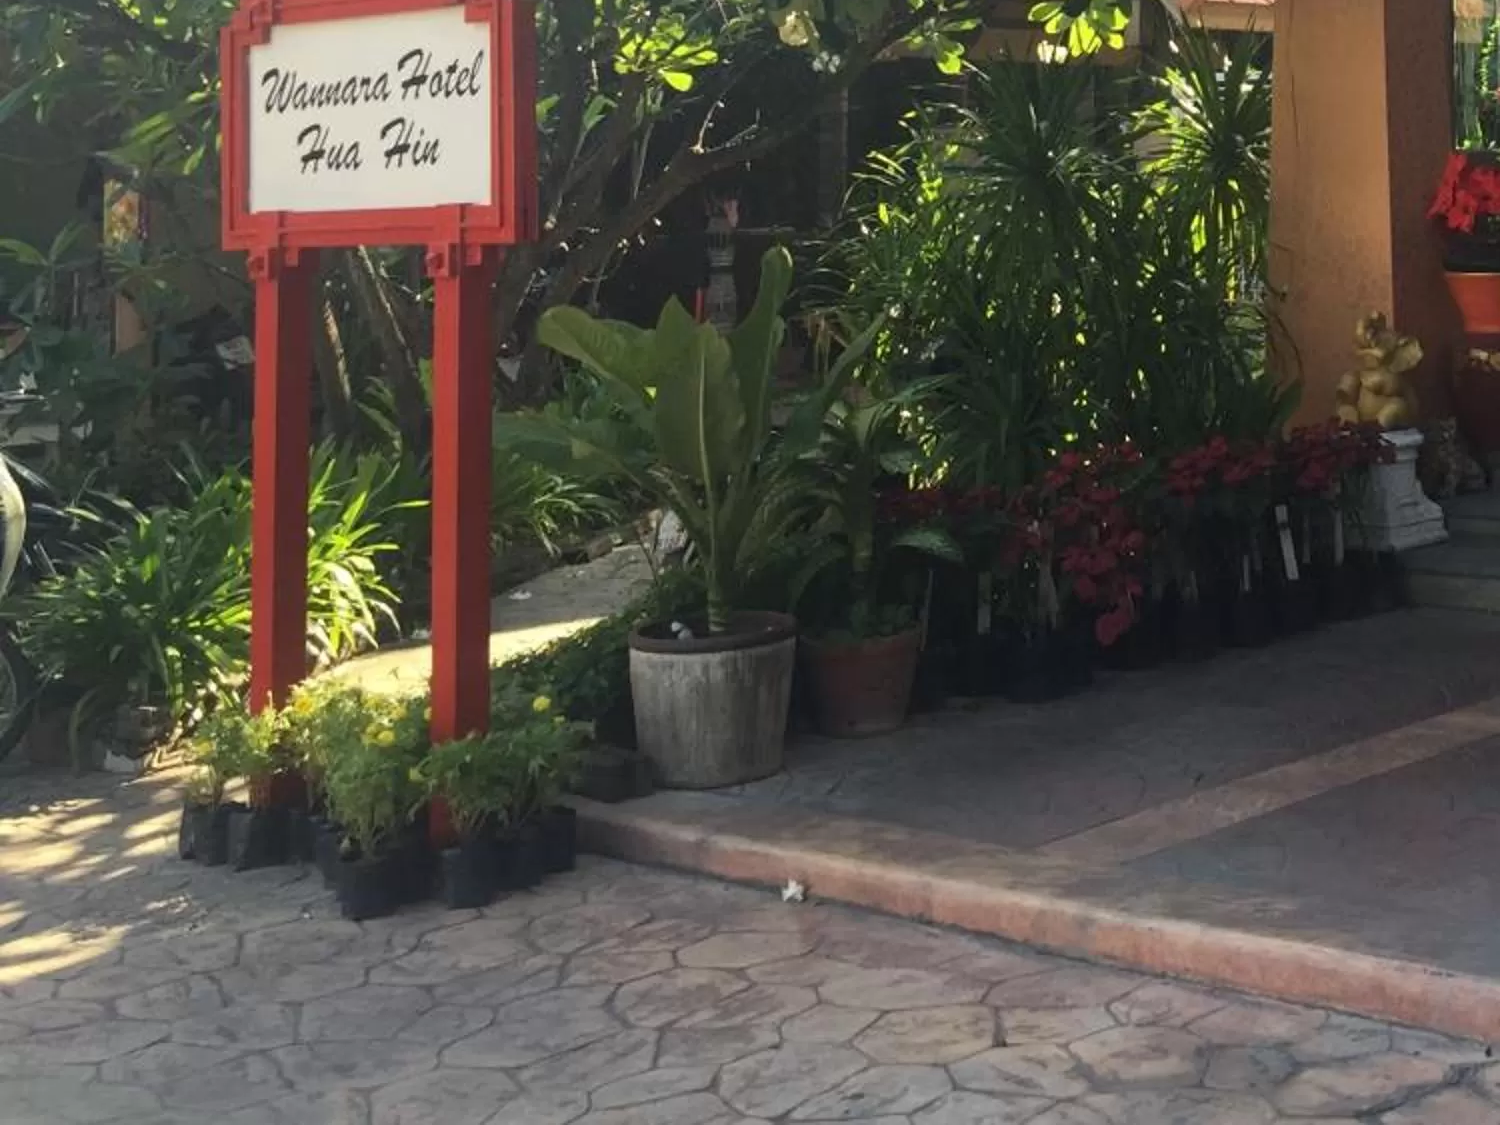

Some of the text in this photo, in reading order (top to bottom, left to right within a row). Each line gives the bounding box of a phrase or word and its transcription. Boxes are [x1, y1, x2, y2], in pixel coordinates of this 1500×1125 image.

[261, 48, 485, 114] Wannara Hotel
[297, 117, 440, 174] Hua Hin
